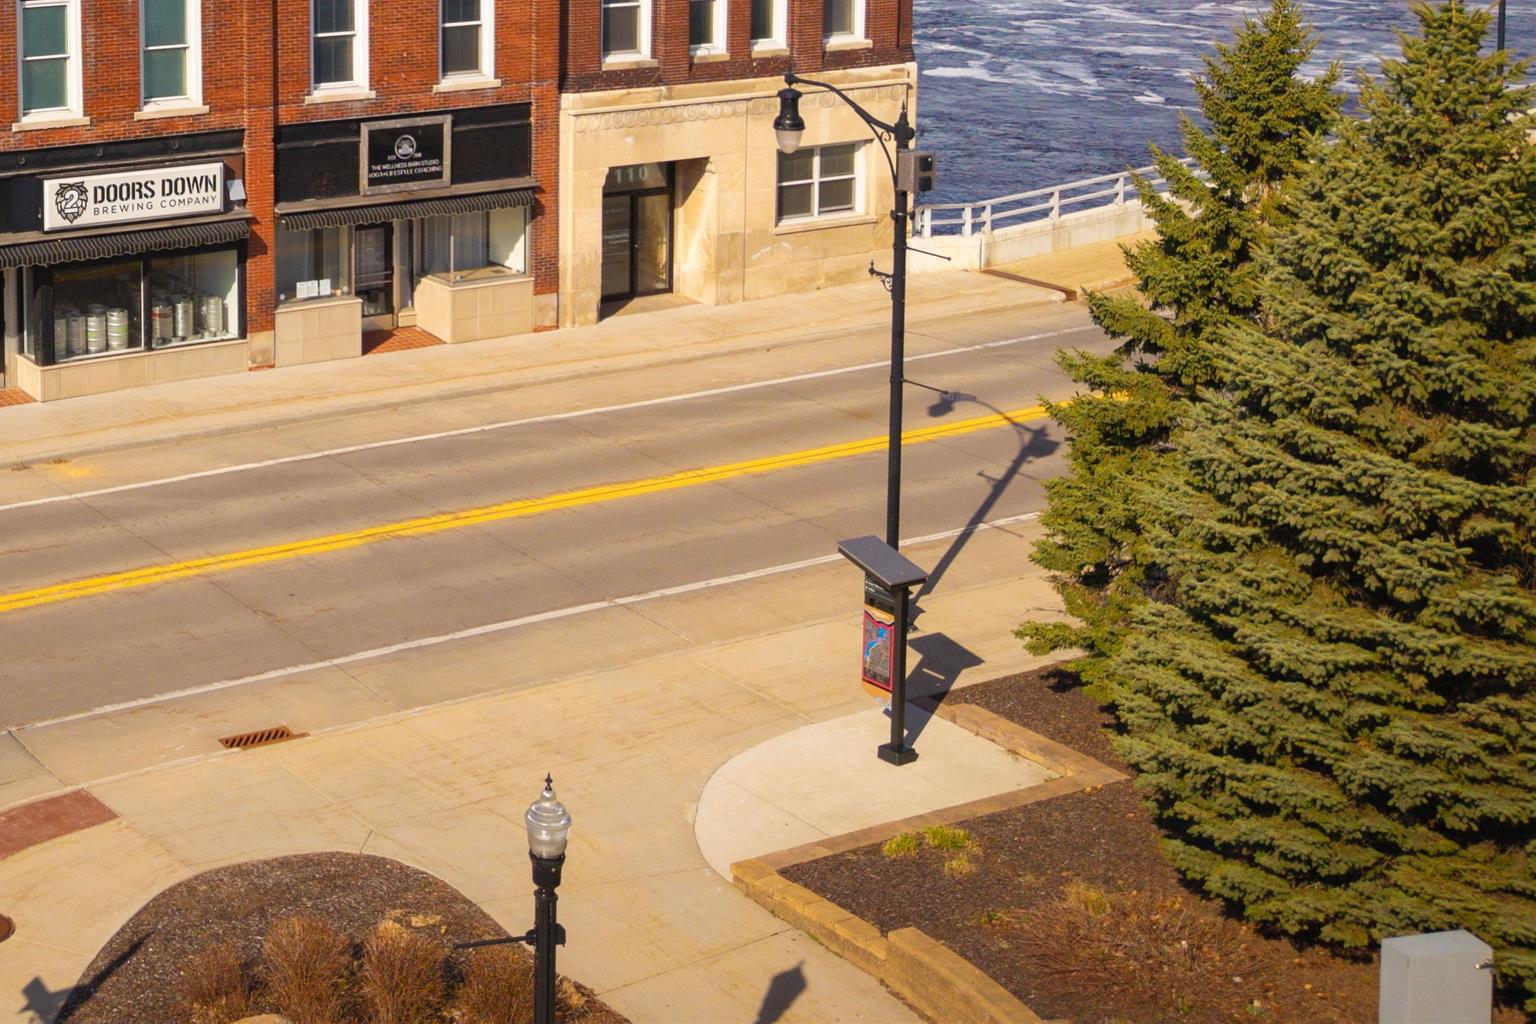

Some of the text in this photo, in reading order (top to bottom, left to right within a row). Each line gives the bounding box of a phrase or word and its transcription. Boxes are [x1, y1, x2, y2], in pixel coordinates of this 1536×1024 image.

[382, 161, 408, 170] WELLNESS
[421, 158, 440, 166] STUDIO
[615, 167, 648, 184] 110
[93, 180, 156, 204] DOORS
[161, 174, 217, 197] DOWN
[93, 195, 217, 216] BREWING COMPANY
